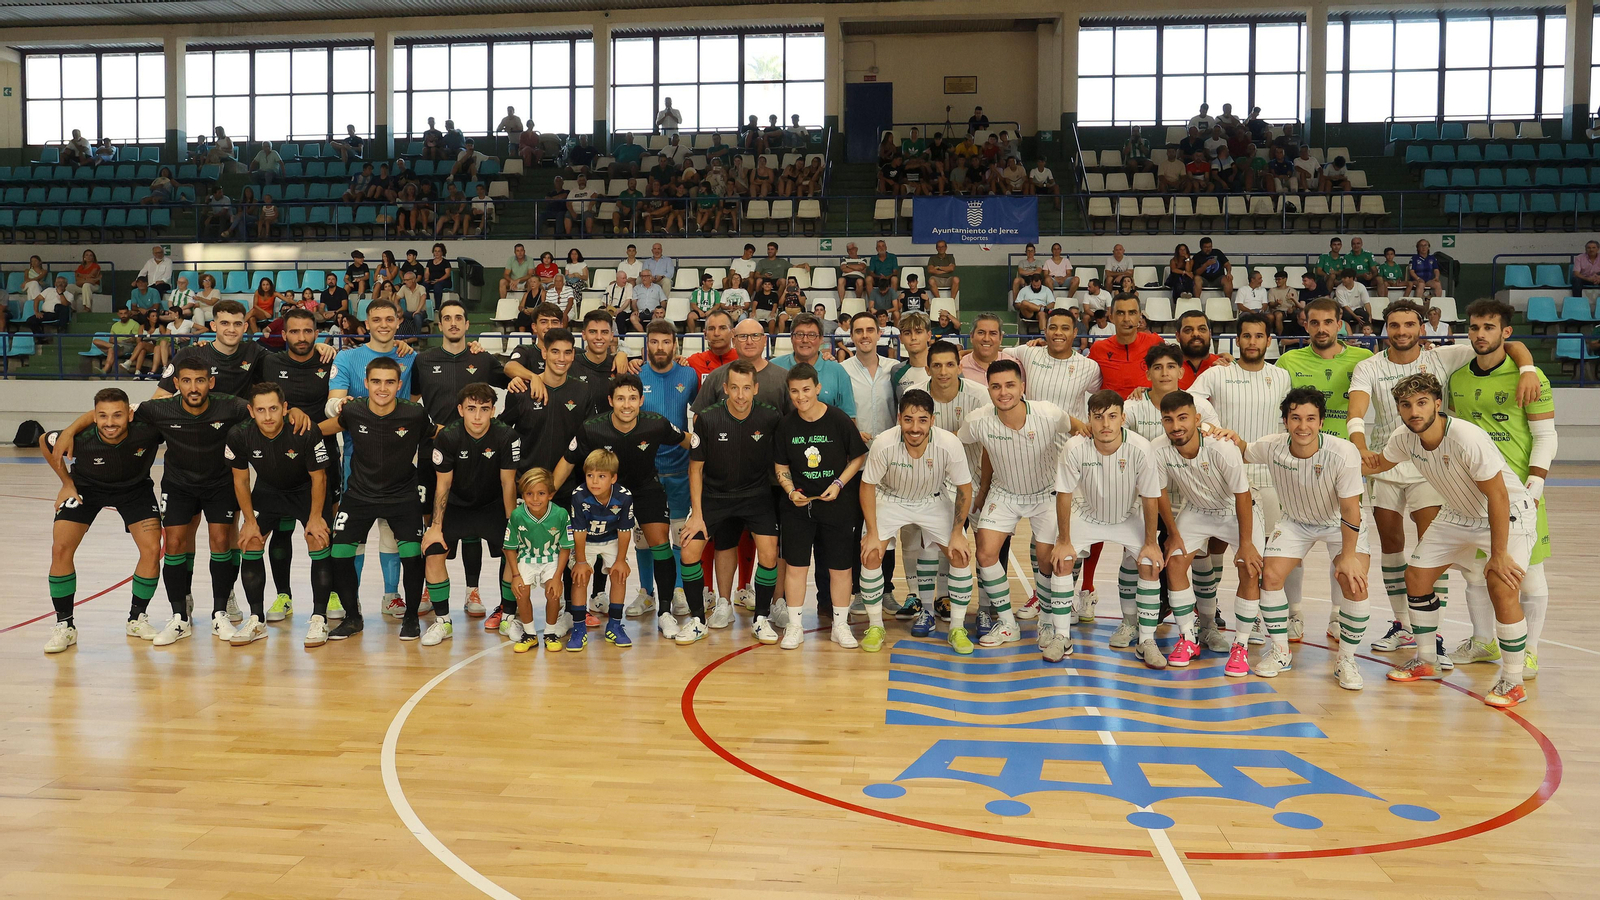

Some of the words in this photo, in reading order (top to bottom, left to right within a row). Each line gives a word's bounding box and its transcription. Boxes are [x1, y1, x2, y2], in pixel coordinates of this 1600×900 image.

[931, 227, 987, 235] Ayuntamiento
[999, 227, 1019, 235] Jerez
[791, 436, 807, 444] AMOR,
[988, 433, 1012, 441] GIVOVA
[1273, 460, 1298, 471] GIVOVA
